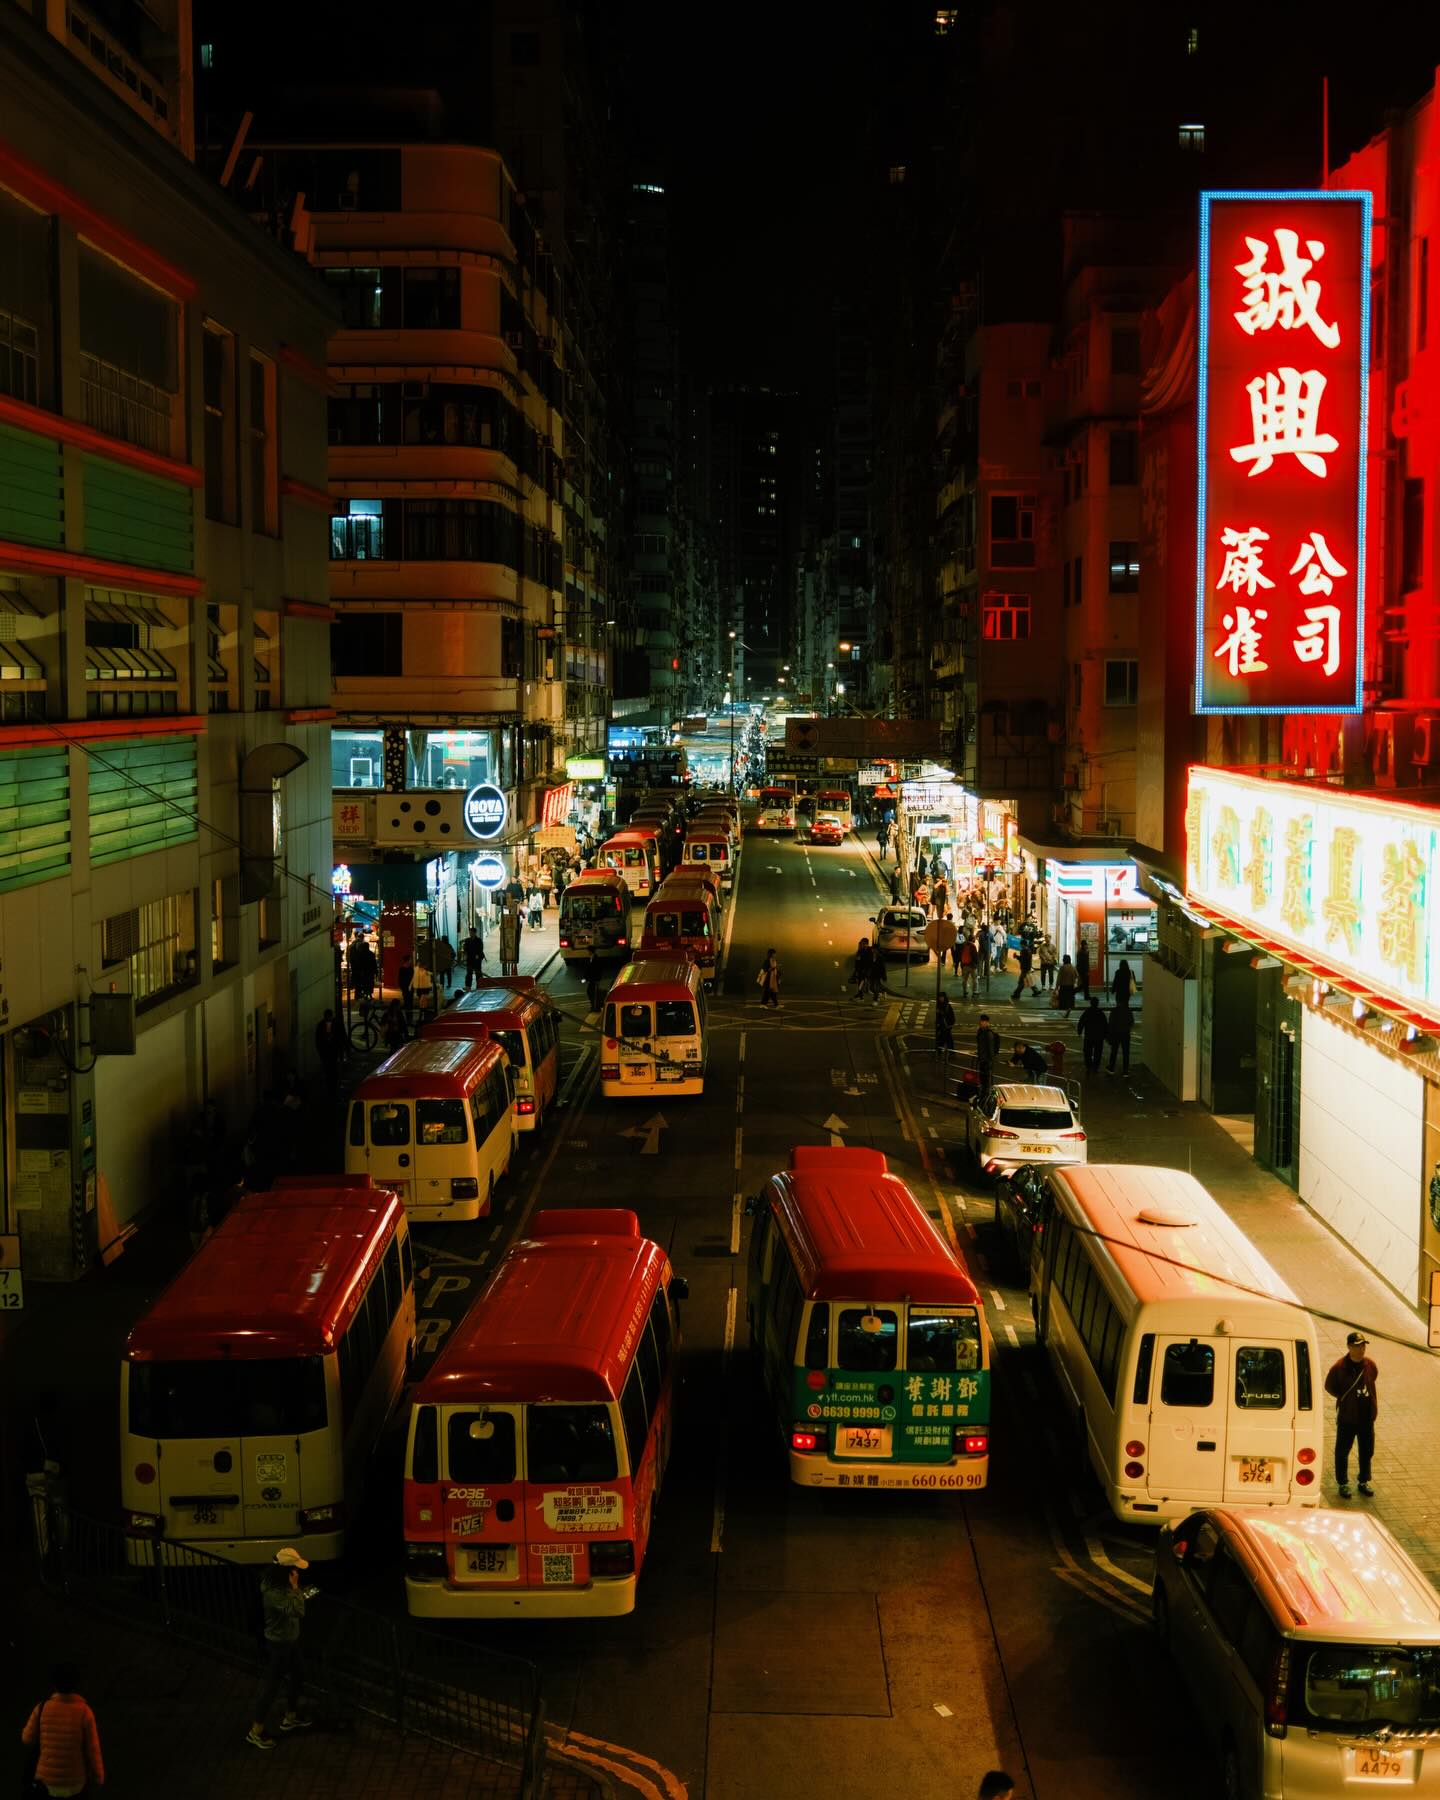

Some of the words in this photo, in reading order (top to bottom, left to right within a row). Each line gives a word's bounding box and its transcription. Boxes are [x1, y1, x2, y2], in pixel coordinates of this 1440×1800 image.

[1230, 228, 1341, 478] 誠興
[1288, 532, 1348, 677] 公司
[469, 799, 503, 814] NOVA
[905, 1376, 978, 1402] 葉謝鄧
[823, 1406, 850, 1418] 6639
[852, 1407, 880, 1418] 9999
[849, 1439, 880, 1448] 7437
[912, 1474, 937, 1487] 660
[940, 1474, 964, 1487] 660
[966, 1475, 982, 1487] 90
[1243, 1473, 1271, 1483] 5764
[448, 1488, 486, 1499] 2036
[469, 1560, 505, 1572] 4627
[1360, 1762, 1401, 1776] 4479
